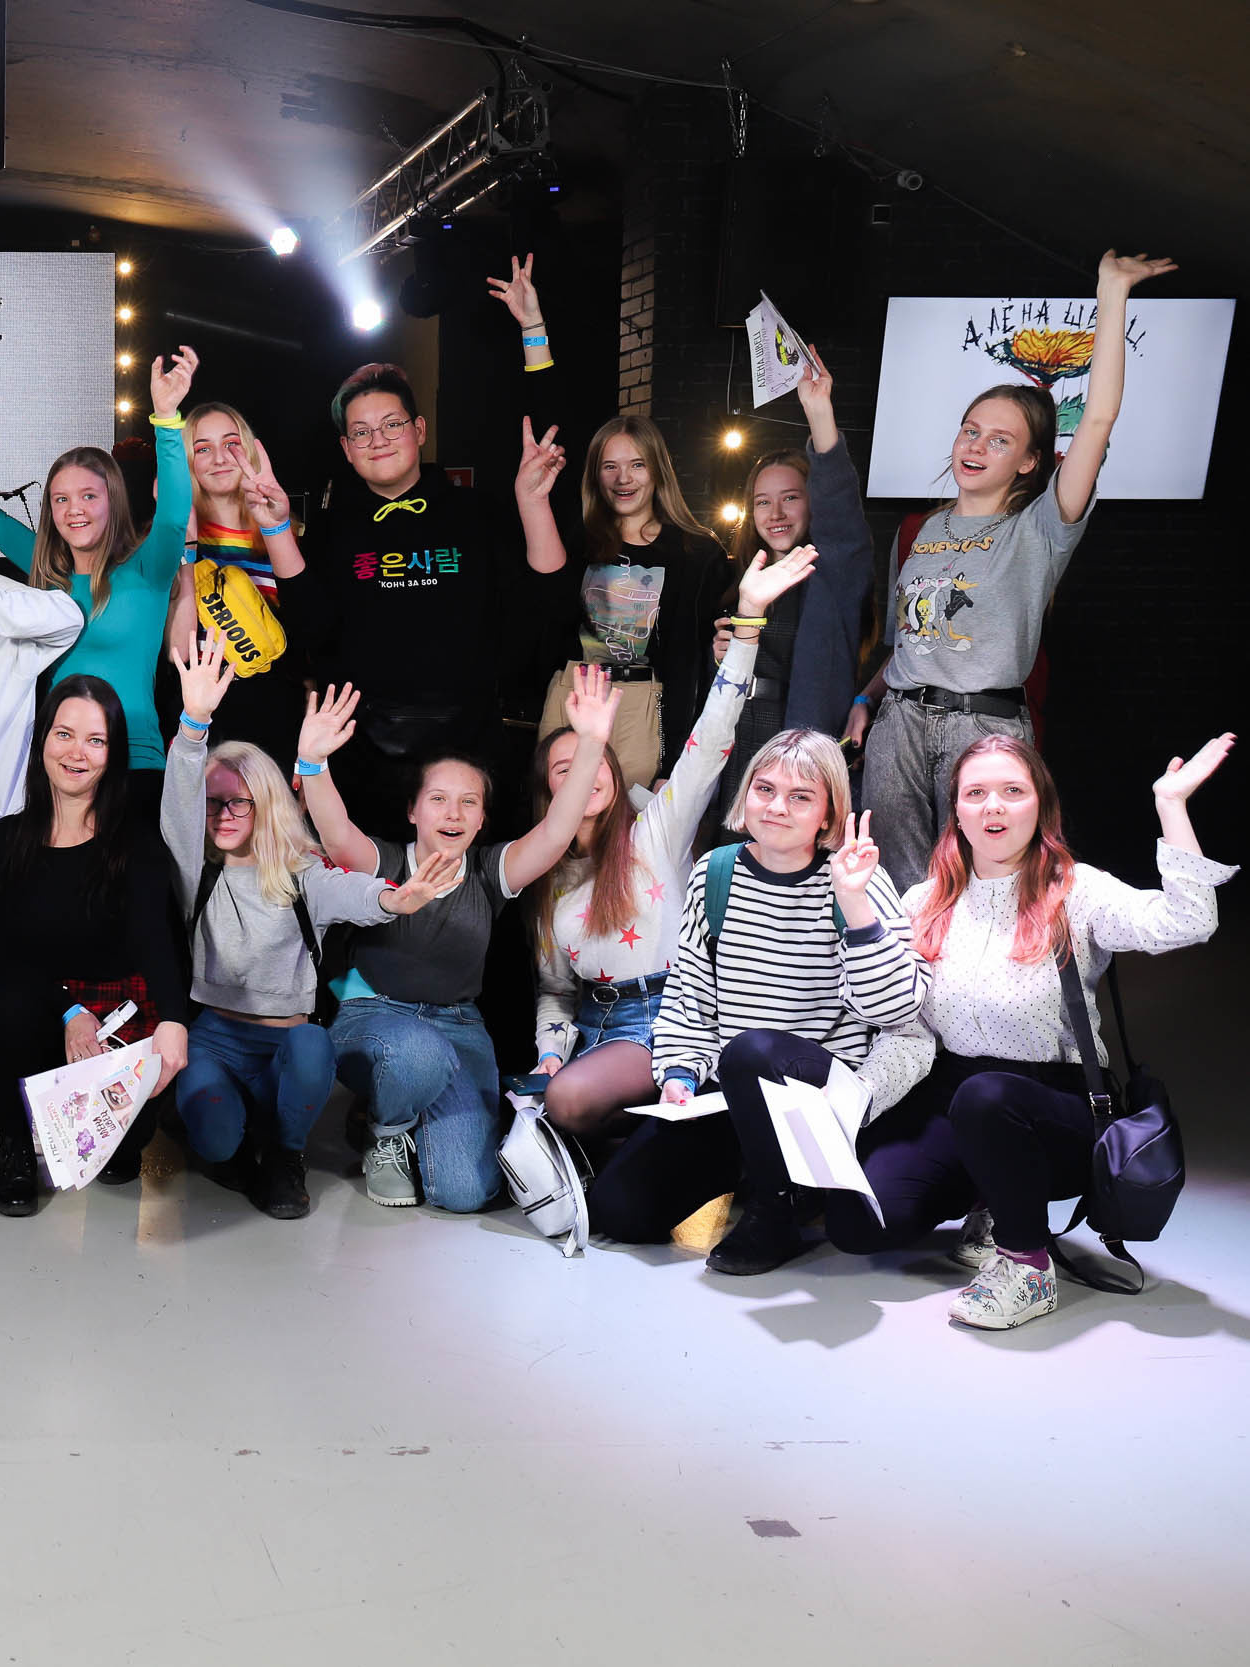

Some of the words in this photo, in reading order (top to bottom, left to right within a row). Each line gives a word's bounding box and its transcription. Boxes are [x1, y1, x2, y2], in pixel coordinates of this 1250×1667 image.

[962, 297, 1050, 351] АЛЁНА
[421, 578, 438, 586] 500
[201, 591, 262, 663] SERIOUS
